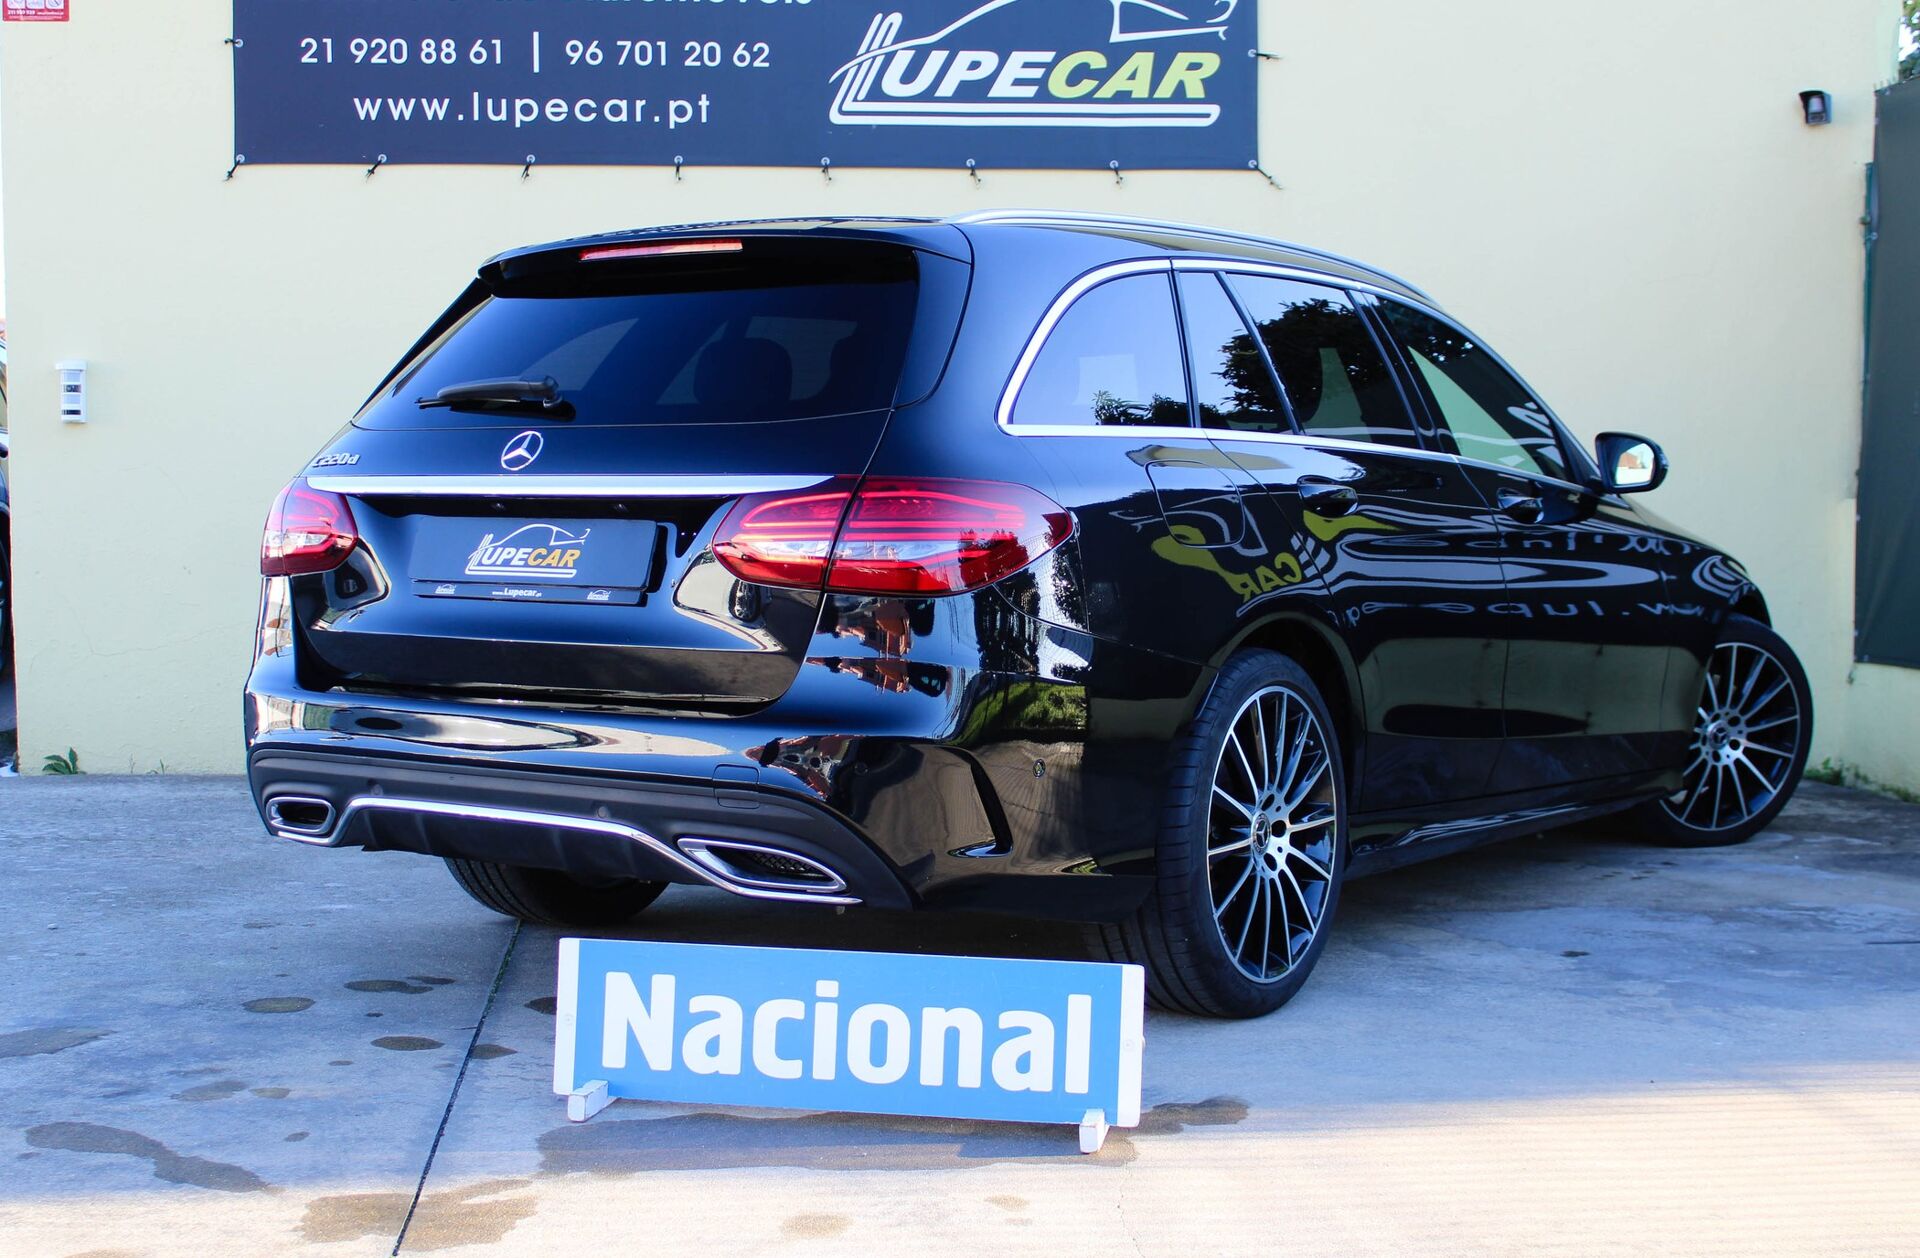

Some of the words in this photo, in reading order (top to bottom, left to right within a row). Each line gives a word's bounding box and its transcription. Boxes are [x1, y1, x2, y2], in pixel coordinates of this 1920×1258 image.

[300, 37, 332, 64] 21
[349, 37, 408, 64] 920
[420, 38, 457, 64] 88
[469, 39, 501, 65] 61
[565, 39, 604, 65] 96
[616, 40, 667, 66] 701
[684, 41, 721, 67] 20
[732, 42, 770, 68] 62
[829, 12, 1221, 126] LUPECAR
[353, 91, 710, 129] www.lupecar.pt
[464, 532, 581, 578] LUPECAR
[603, 972, 1092, 1094] Nacional
